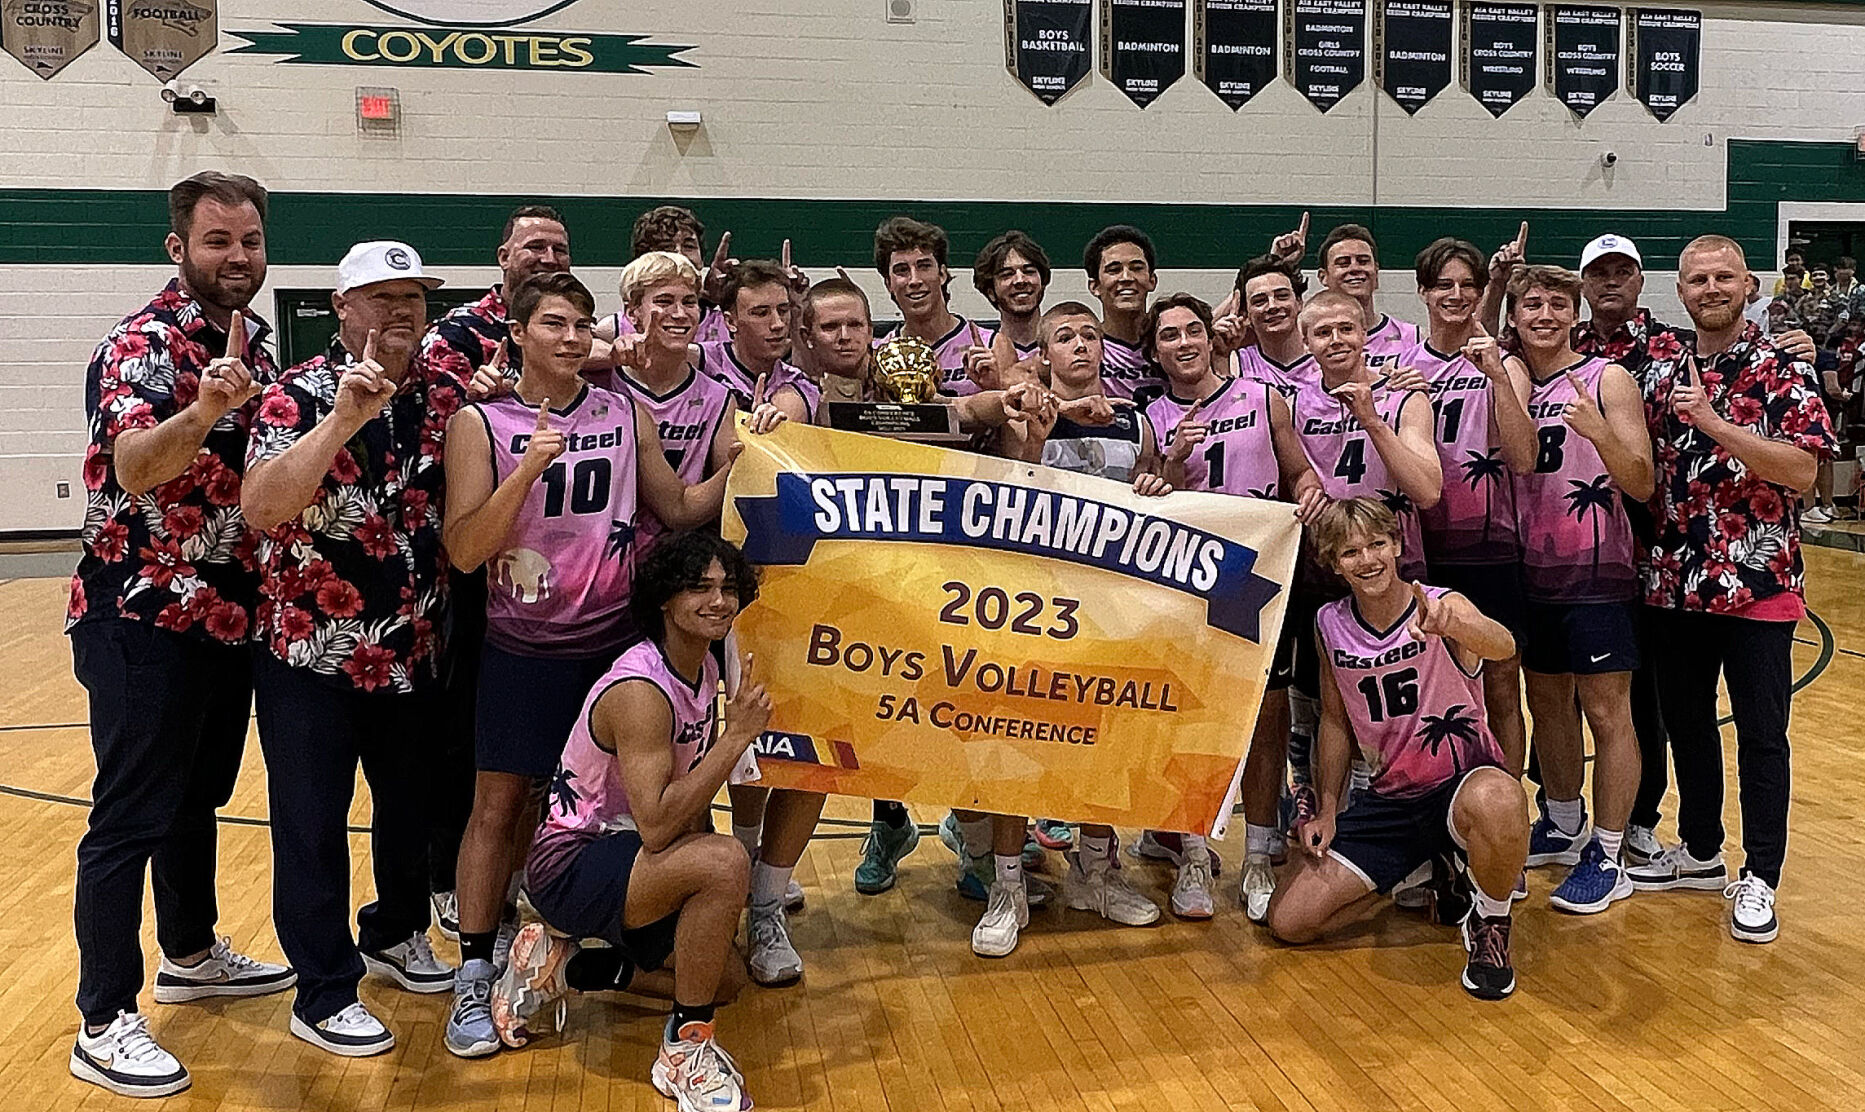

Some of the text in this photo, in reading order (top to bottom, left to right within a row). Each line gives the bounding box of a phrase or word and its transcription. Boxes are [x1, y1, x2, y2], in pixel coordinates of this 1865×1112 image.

[24, 4, 69, 15] CROSS
[134, 8, 200, 20] FOOTBALL
[16, 16, 83, 28] COUNTRY
[1039, 30, 1068, 40] BOYS
[1306, 25, 1353, 33] BADMINTON
[342, 30, 594, 67] COYOTES
[1022, 40, 1085, 51] BASKETBALL
[1118, 42, 1179, 52] BADMINTON
[1212, 45, 1270, 55] BADMINTON
[1390, 51, 1445, 61] BADMINTON
[1655, 52, 1680, 61] BOYS
[1310, 65, 1348, 73] FOOTBALL
[1651, 62, 1684, 71] SOCCER
[1430, 376, 1487, 394] steel
[1165, 410, 1256, 446] Cteel
[510, 426, 623, 455] Cteel
[1204, 441, 1225, 488] 1
[1334, 438, 1366, 485] 4
[542, 457, 611, 518] 10
[811, 478, 1223, 592] STATE CHAMPIONS
[940, 581, 1080, 640] 2023
[1356, 667, 1420, 722] 16
[875, 695, 920, 725] 5A
